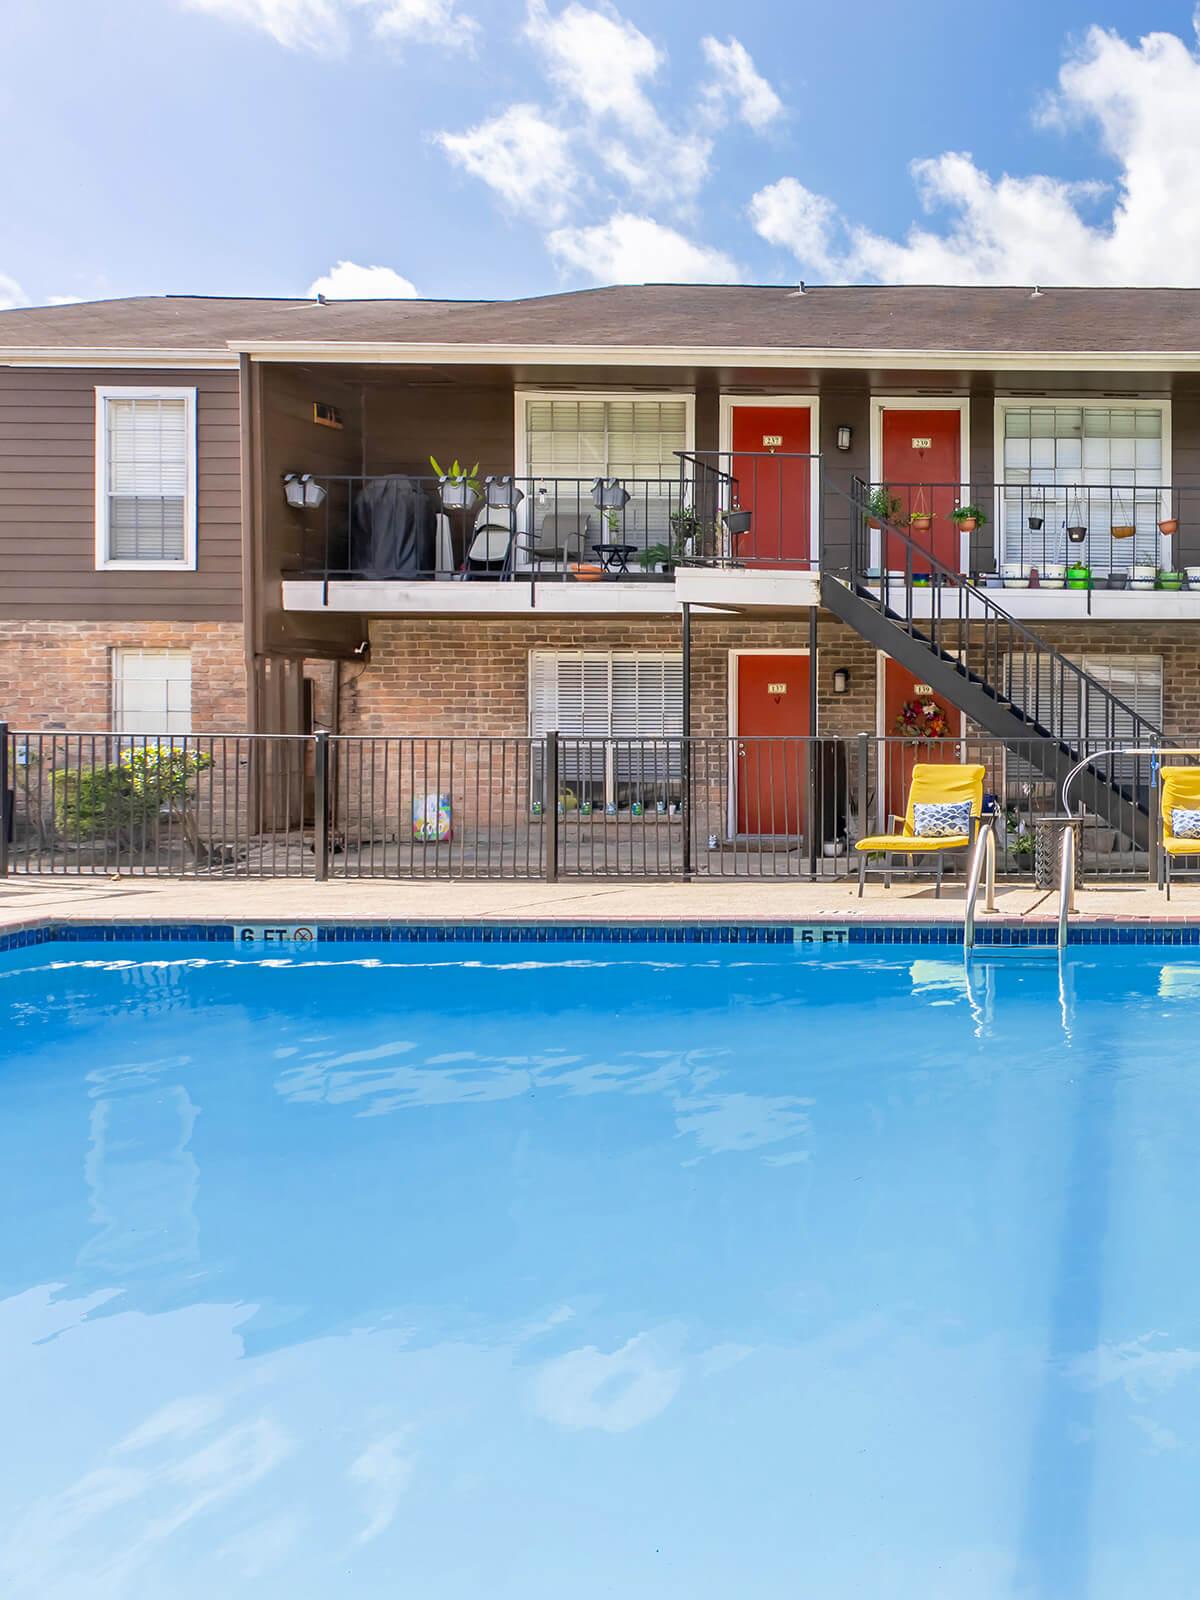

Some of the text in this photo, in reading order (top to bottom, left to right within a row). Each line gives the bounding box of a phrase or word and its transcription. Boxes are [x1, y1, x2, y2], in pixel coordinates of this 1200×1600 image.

[241, 928, 287, 942] 6 FT
[802, 930, 847, 943] 5 FT
